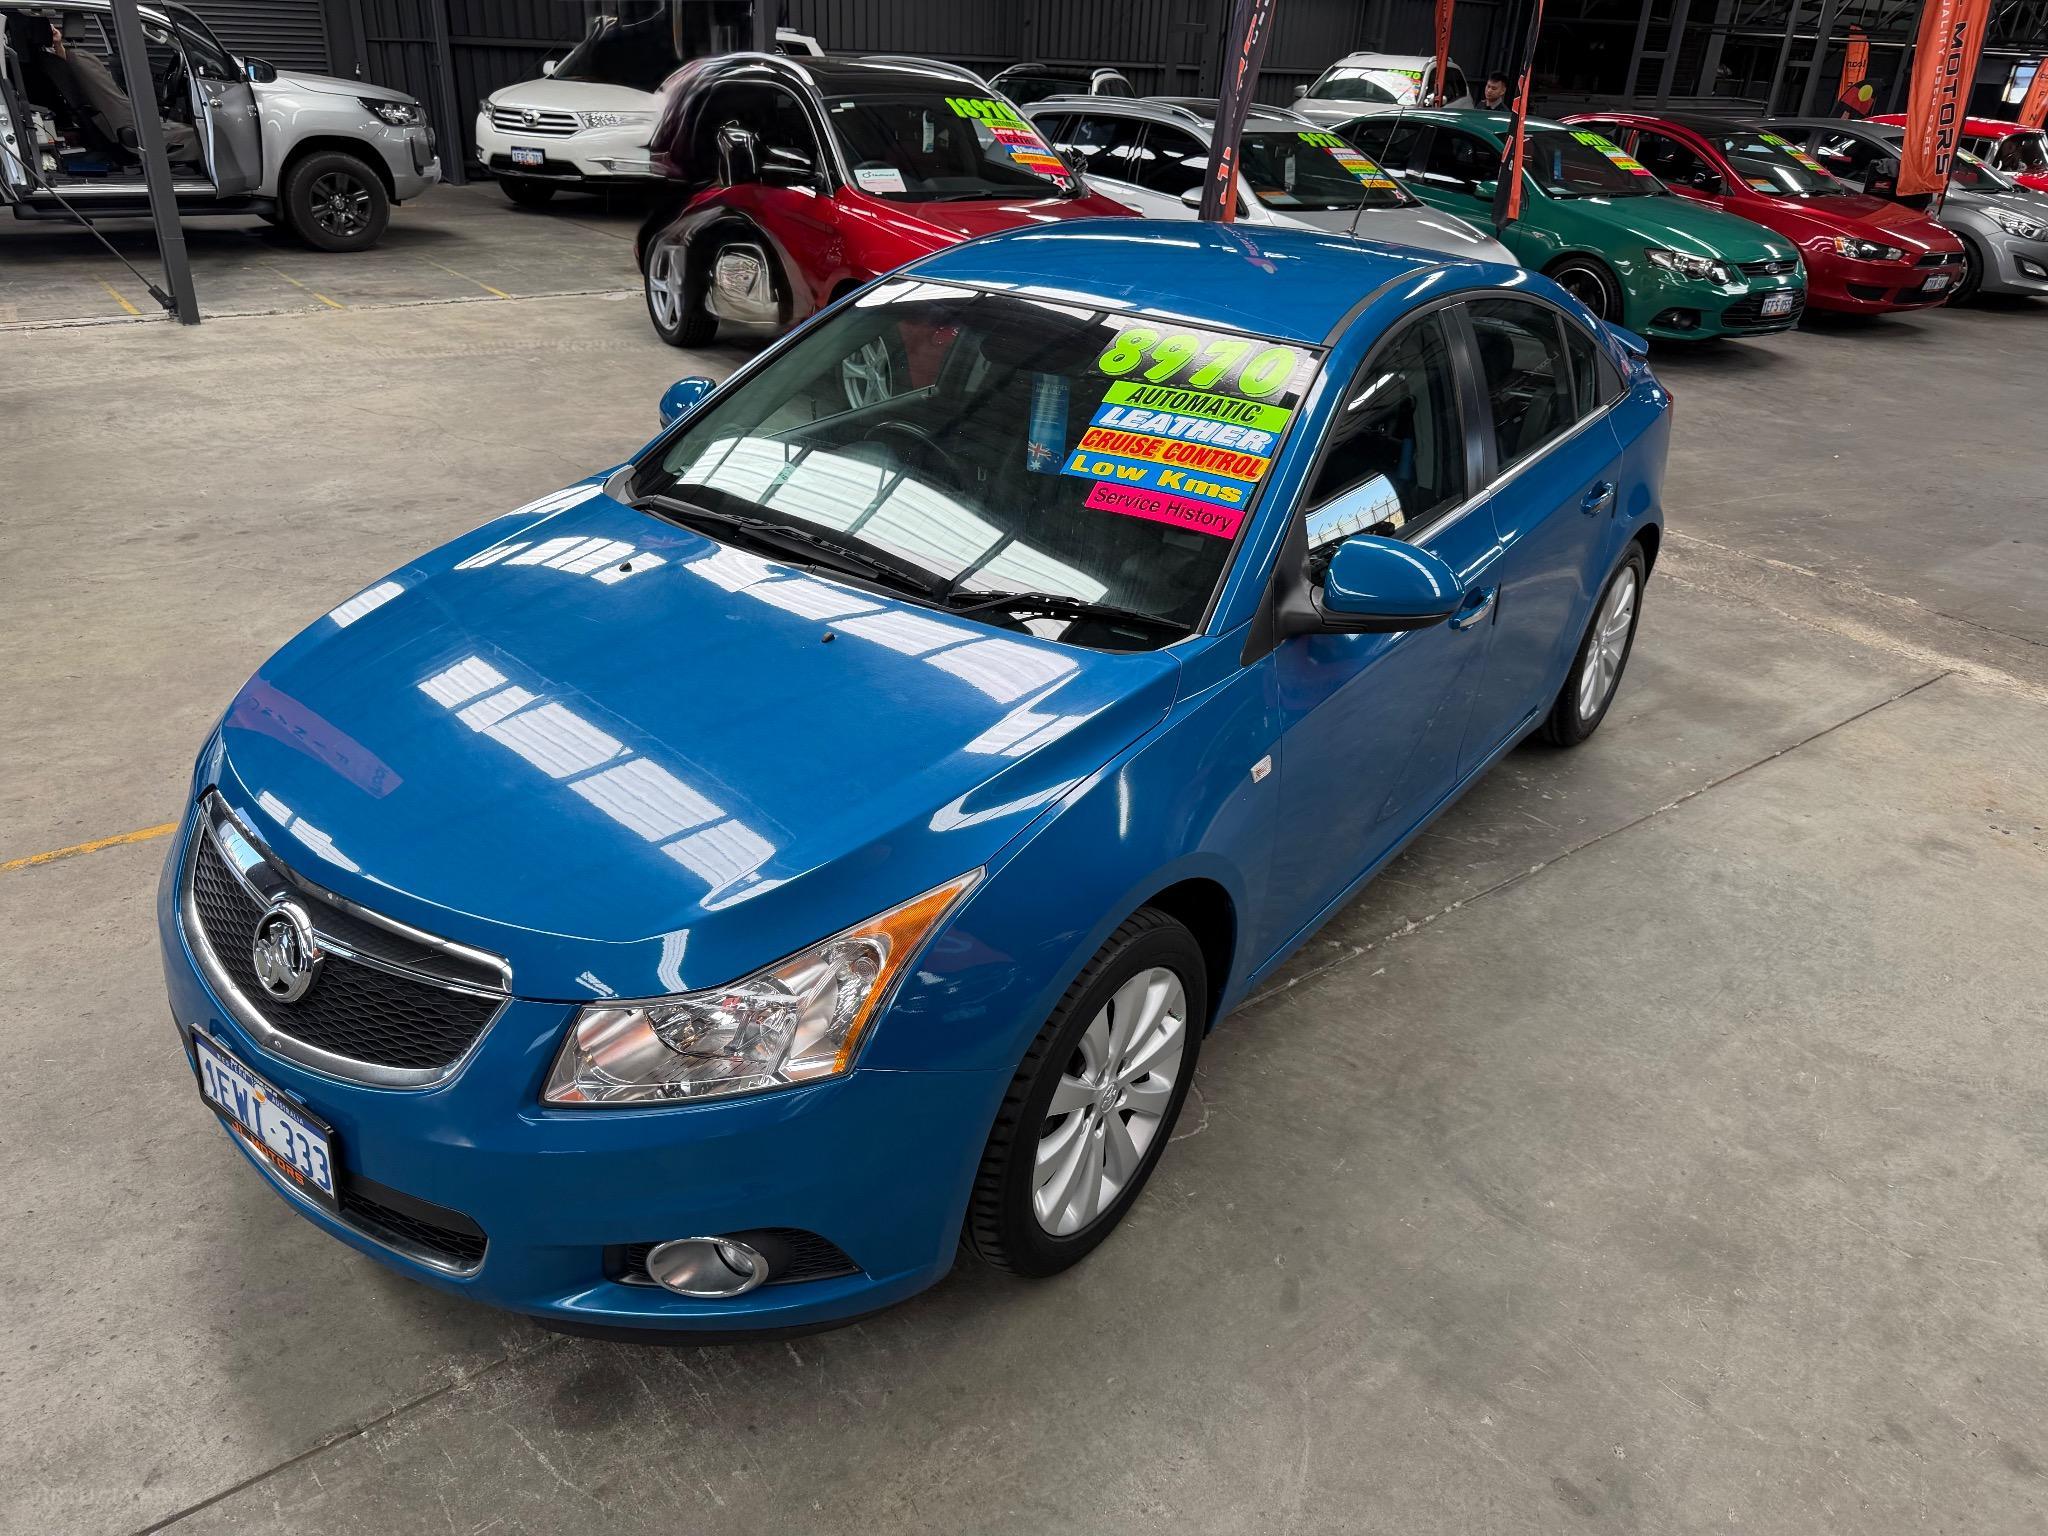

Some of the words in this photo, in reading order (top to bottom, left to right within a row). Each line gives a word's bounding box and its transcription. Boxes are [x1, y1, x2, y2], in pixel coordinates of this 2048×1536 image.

[945, 97, 1017, 120] 18970
[1935, 21, 1967, 176] MOTORS
[1923, 114, 1935, 156] CARS
[1098, 328, 1298, 398] 8970
[1126, 386, 1263, 423] AUTOMATIC
[1098, 406, 1273, 453] LEATHER
[1081, 429, 1164, 459] CRUISE
[1162, 442, 1266, 479] CONTROL
[1070, 454, 1148, 481] Low
[1156, 469, 1243, 503] Kms
[1094, 487, 1160, 513] Service
[1166, 503, 1233, 534] History
[249, 1134, 305, 1186] MOTORS
